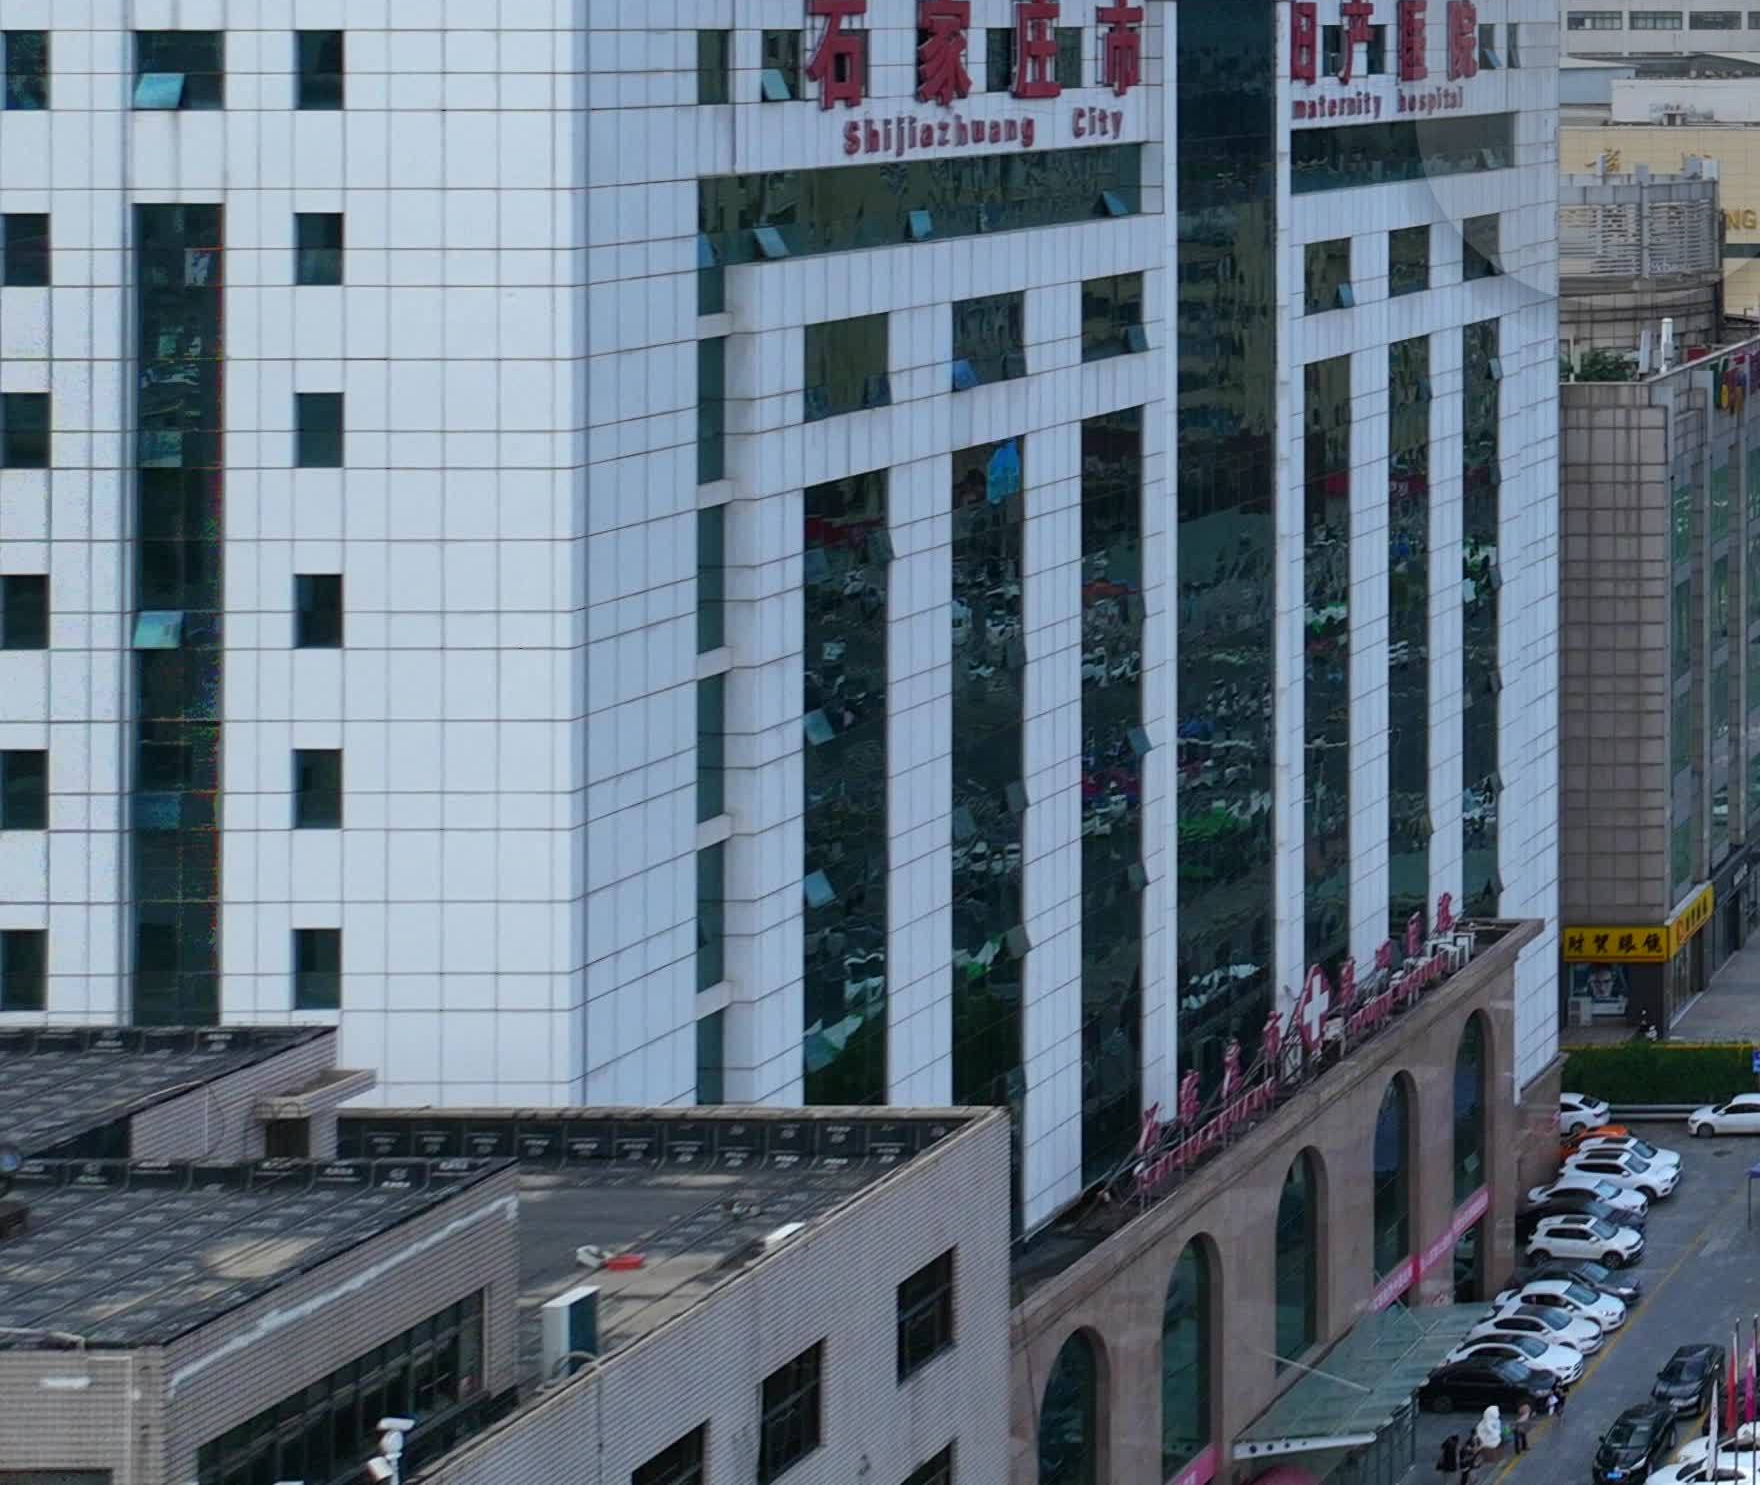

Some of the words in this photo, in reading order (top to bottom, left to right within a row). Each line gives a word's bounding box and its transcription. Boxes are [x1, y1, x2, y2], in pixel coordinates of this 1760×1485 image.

[843, 113, 1036, 157] Shijiazhuang
[1071, 105, 1124, 140] City
[1397, 86, 1464, 115] hospital
